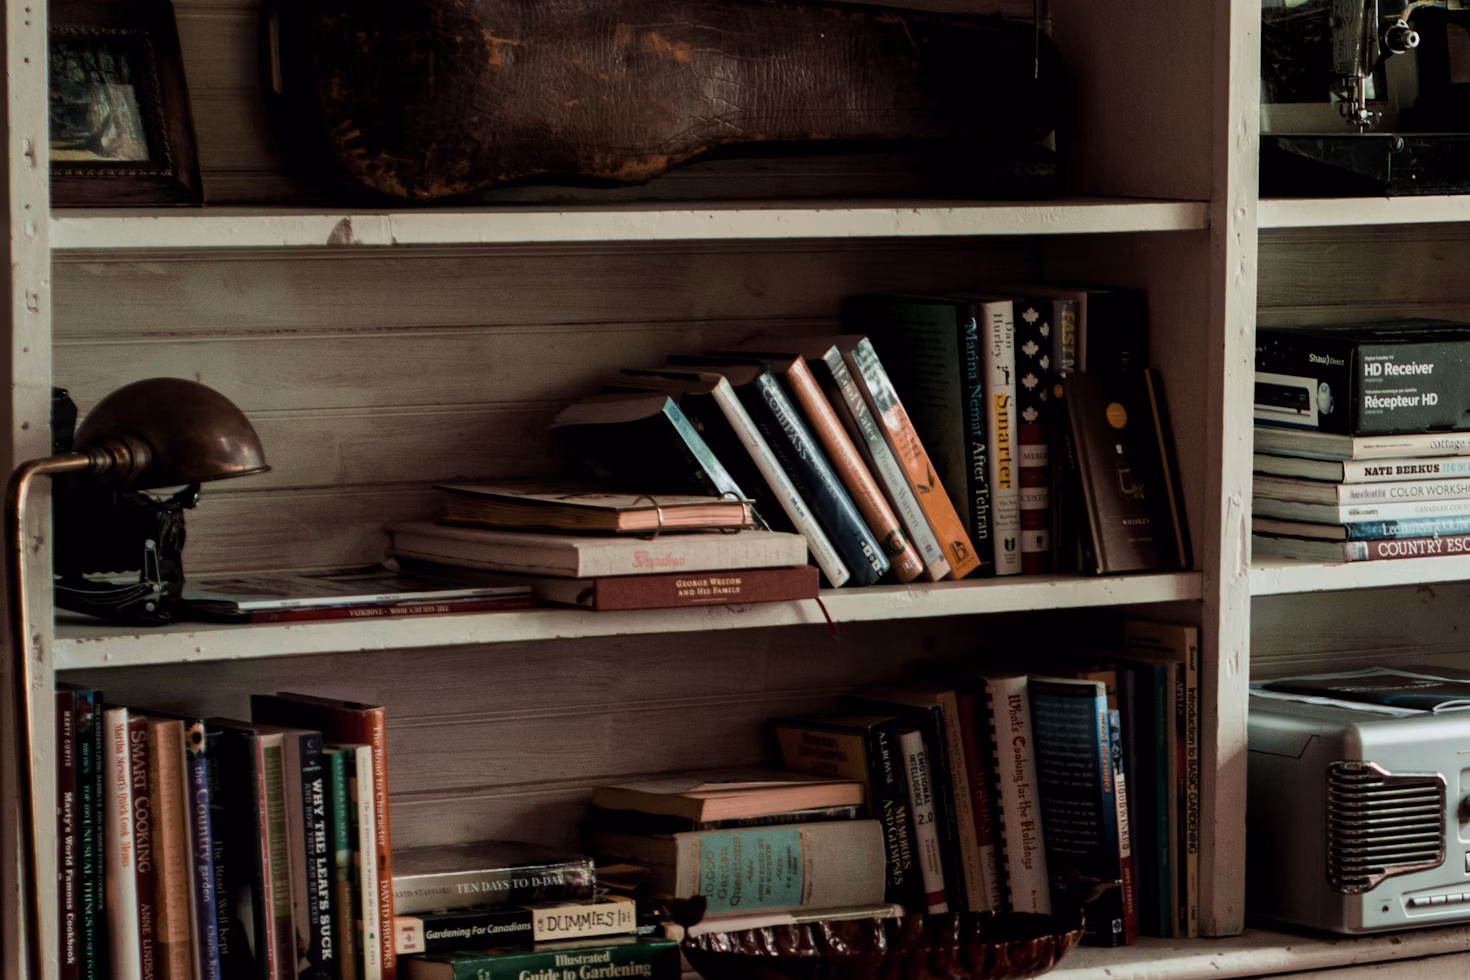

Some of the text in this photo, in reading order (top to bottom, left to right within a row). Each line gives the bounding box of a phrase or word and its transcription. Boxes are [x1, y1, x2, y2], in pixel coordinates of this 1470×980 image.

[991, 314, 1004, 358] Hurley
[1005, 321, 1014, 348] Dan
[1062, 311, 1076, 357] FAST
[1329, 356, 1345, 366] Direct
[1364, 361, 1434, 377] HD Receiver
[1364, 393, 1439, 410] Récepteur HD
[759, 383, 812, 461] COMPASS
[964, 324, 990, 539] Marina Nemat After Tehran
[835, 368, 921, 528] Cool Water Dianne Warren
[997, 395, 1013, 488] Smarter
[1430, 439, 1465, 451] cottage
[1364, 466, 1393, 476] NATE
[1396, 464, 1440, 475] BERKUS
[789, 496, 806, 518] MAN
[1389, 486, 1424, 498] COLOR
[1415, 505, 1449, 513] CANADIAN
[1382, 522, 1400, 536] Lee
[1378, 539, 1443, 557] COUNTRY
[675, 577, 741, 588] GEORGE WESTON
[678, 586, 740, 596] AND HIS FAMILY
[95, 716, 103, 749] CANADIAN
[82, 742, 91, 774] BROWN
[95, 750, 103, 772] LIVING
[130, 730, 148, 791] SMART
[1101, 743, 1112, 793] messages
[1187, 646, 1197, 855] Sunset Introduction to BASIC GARDENING
[83, 784, 91, 802] TOP
[193, 768, 205, 785] the
[908, 754, 923, 808] INTELLIGENCE
[917, 752, 931, 806] EMOTIONAL
[1008, 694, 1037, 870] What's Cooking for the Holidays
[83, 804, 91, 819] 100
[113, 724, 131, 868] Martha Stewart's Quick Cook Menus
[193, 787, 213, 861] Country
[918, 812, 933, 825] 2.0
[1116, 781, 1130, 850] HOODWINKED
[63, 711, 76, 965] MARTY CURTIS Marty's World Famous Cookbook
[83, 819, 93, 878] UNUSUAL
[134, 795, 152, 873] COOKING
[371, 725, 393, 969] The Road to Character DAVID BROOKS
[882, 799, 904, 886] AND GLIMPSES
[893, 805, 913, 870] MEMORIES
[304, 783, 319, 924] AND HOW THEY CAN BE FIXED
[312, 778, 332, 960] WHY THE LEAFS SUCK
[197, 865, 213, 902] garden
[415, 875, 564, 897] STAFFORD TEN DAYS TO D-DAY
[705, 850, 715, 898] 10,000
[717, 847, 728, 899] Garden
[729, 836, 742, 907] Questions
[84, 879, 95, 928] THINGS
[213, 841, 230, 955] The Road Well Kept
[86, 929, 94, 941] TO
[140, 903, 153, 935] ANNE
[426, 921, 532, 940] Gardening For Canadians
[547, 911, 614, 931] DUMMIES
[206, 925, 217, 958] Charlie
[554, 950, 611, 967] Illustrated
[86, 960, 95, 969] IN
[579, 961, 653, 980] Gardening
